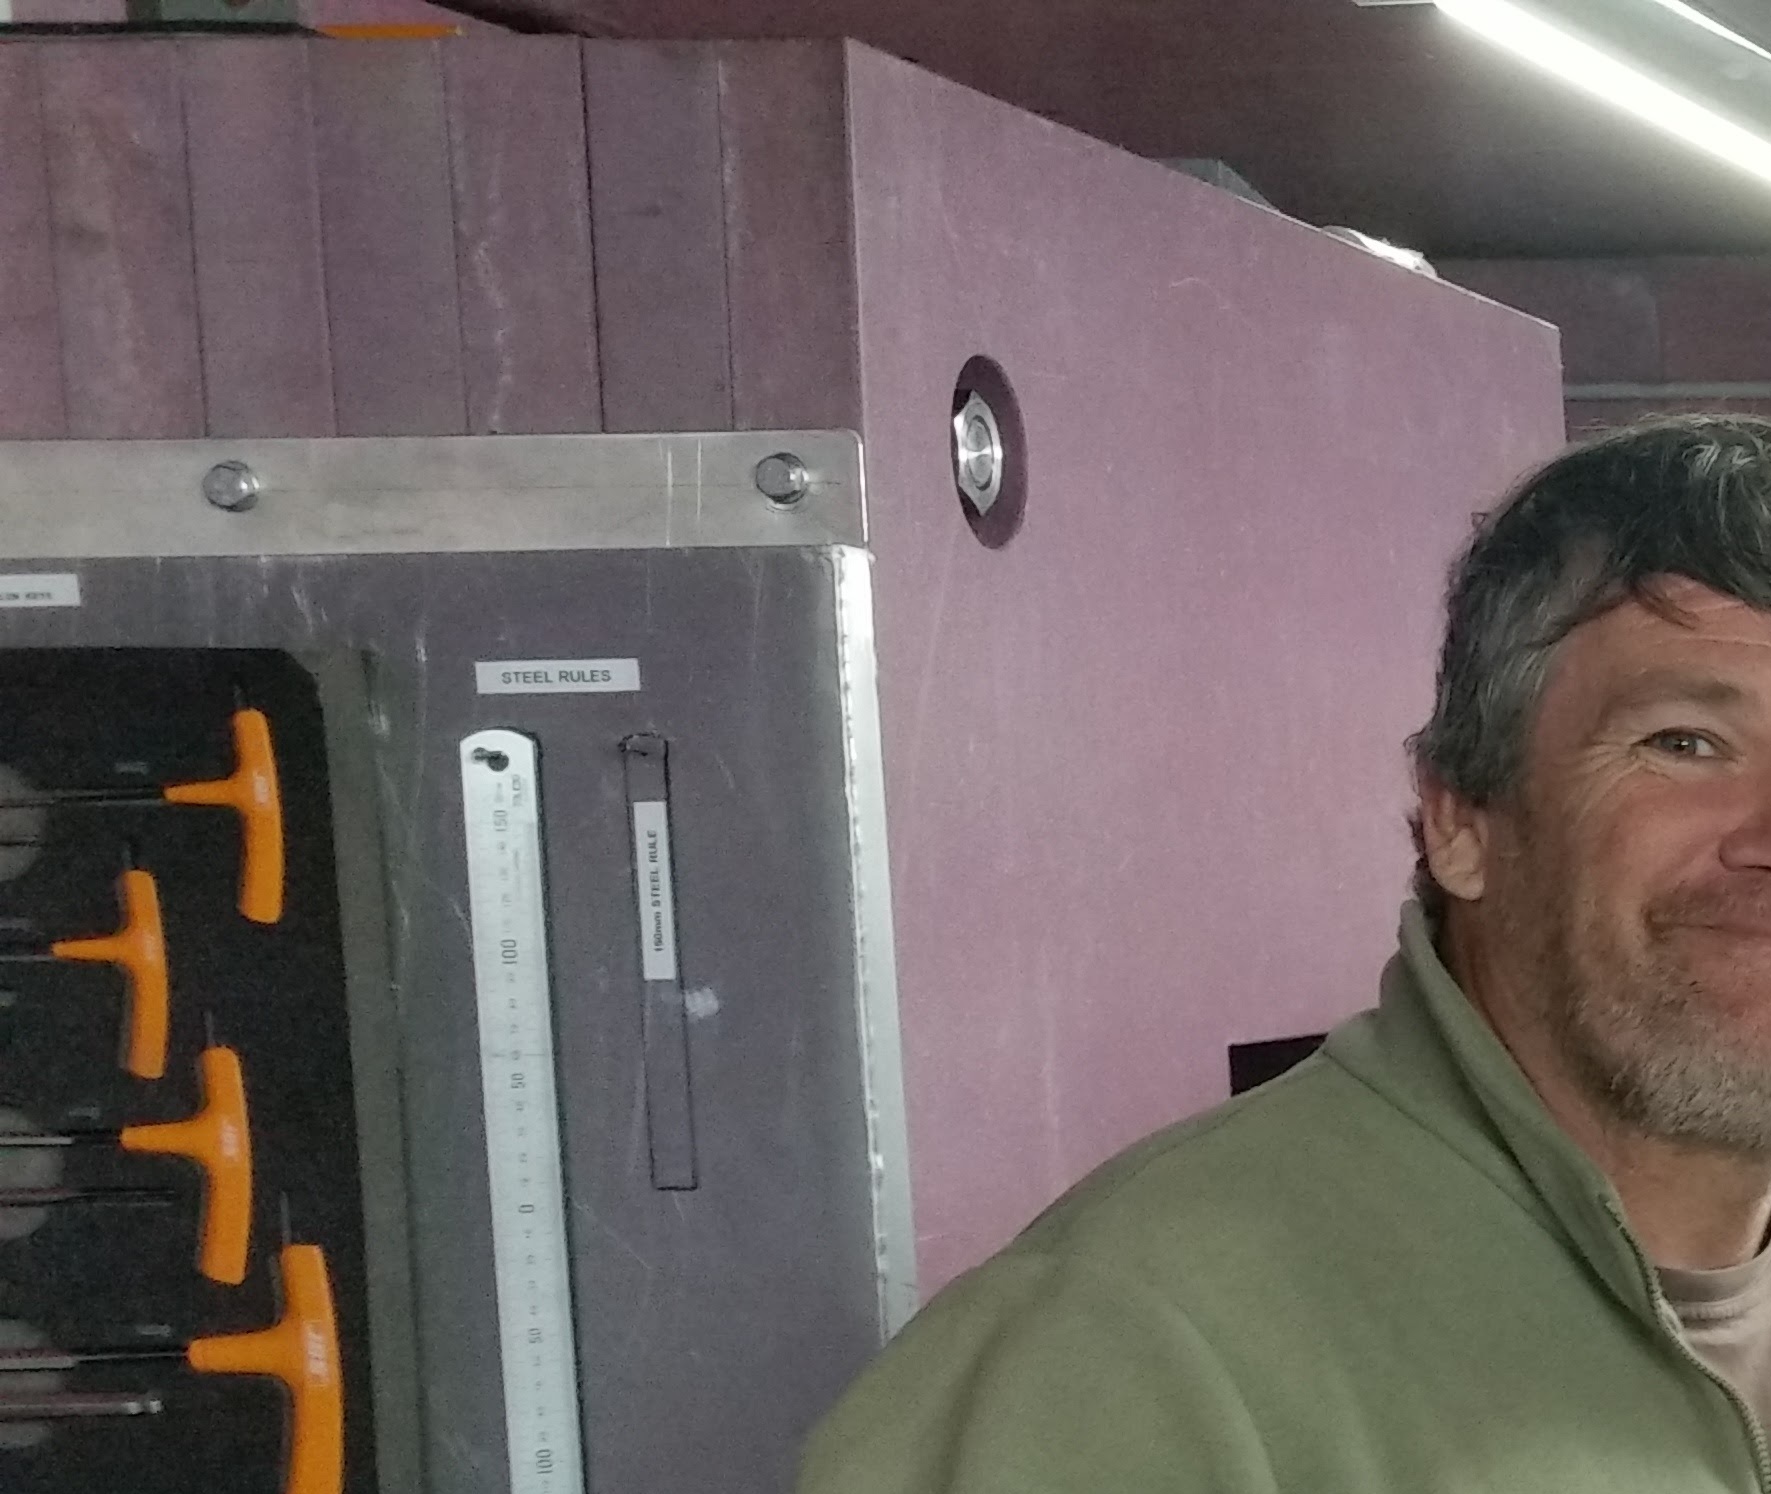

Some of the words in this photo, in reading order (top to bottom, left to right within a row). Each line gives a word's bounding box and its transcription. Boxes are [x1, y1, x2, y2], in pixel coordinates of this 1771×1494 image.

[501, 671, 553, 684] STEEL
[558, 669, 612, 683] RULES
[493, 810, 508, 832] 150
[647, 829, 659, 863] RULE
[649, 869, 662, 907] STEEL
[500, 938, 518, 965] 100
[511, 1072, 526, 1089] 50
[535, 1448, 554, 1475] 100
